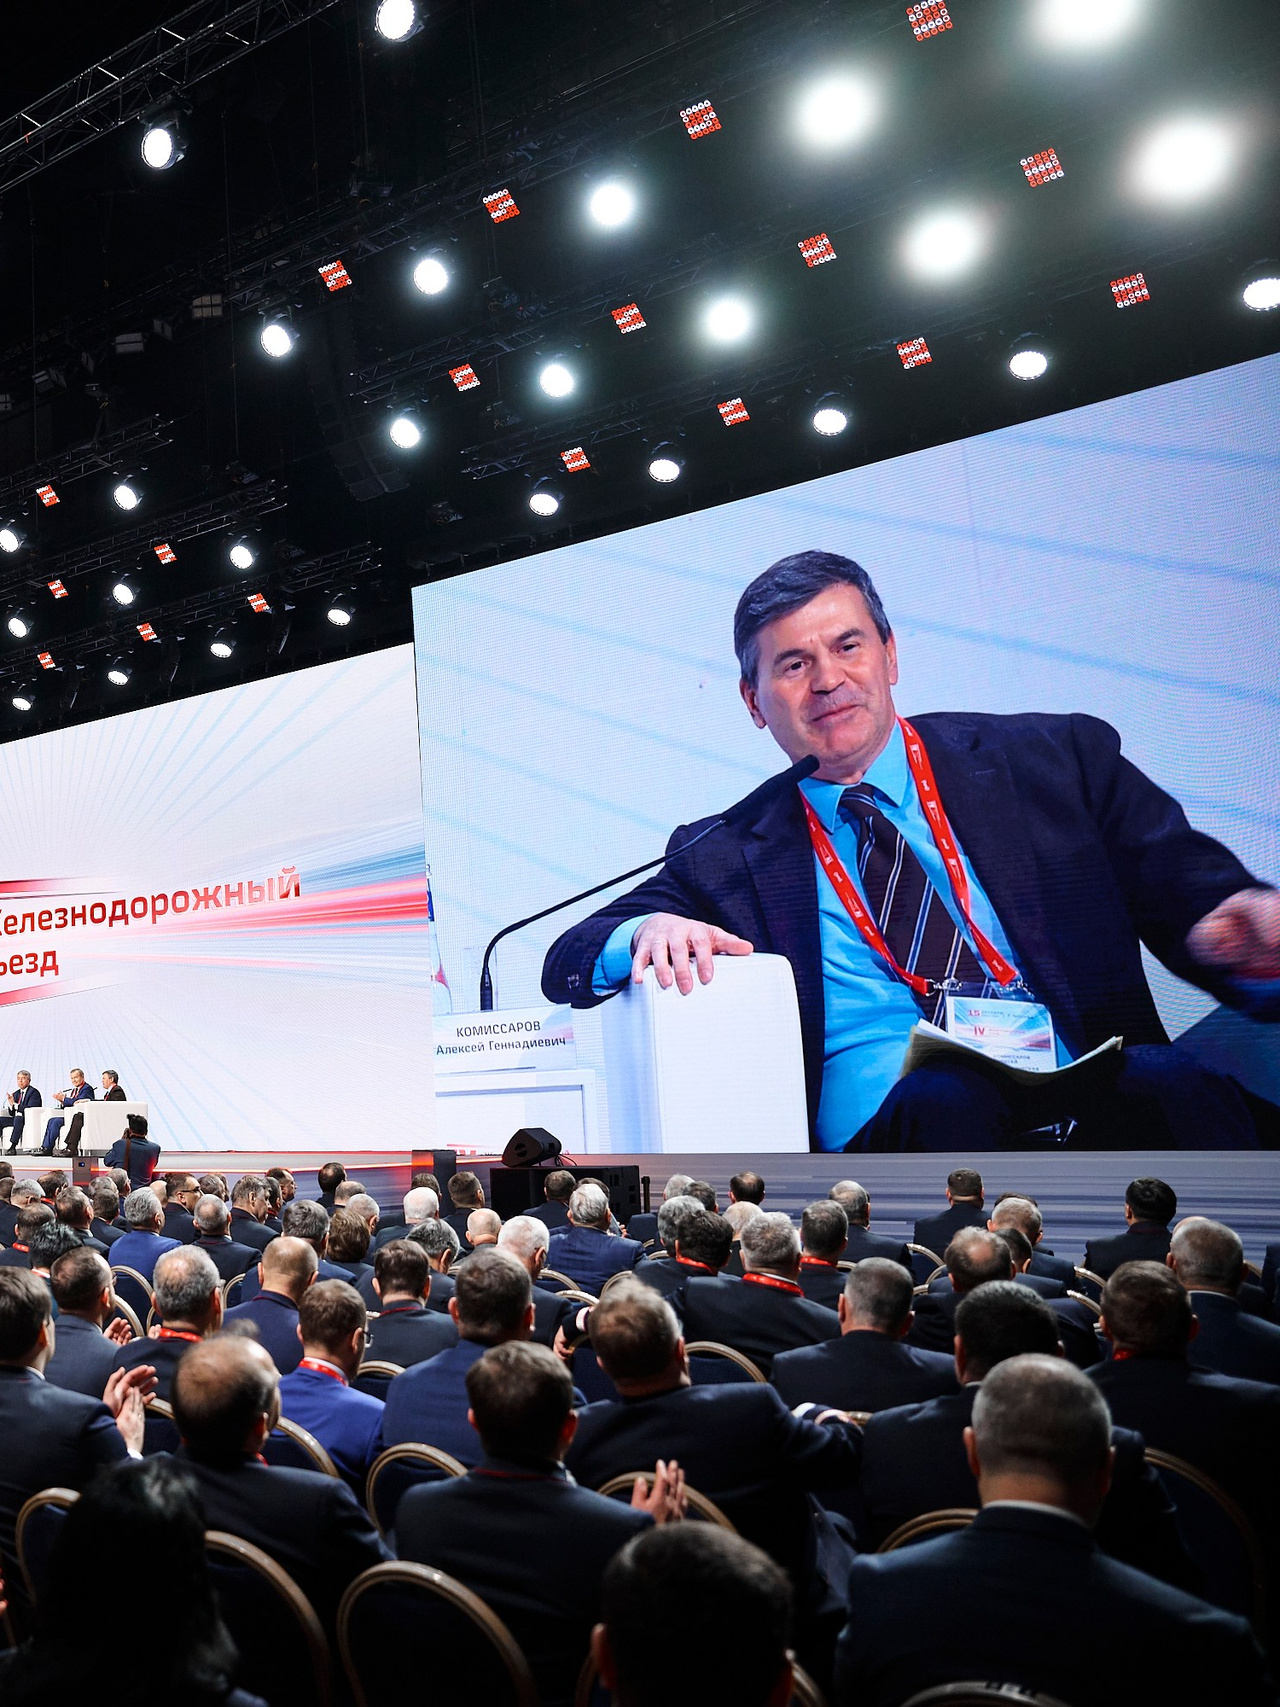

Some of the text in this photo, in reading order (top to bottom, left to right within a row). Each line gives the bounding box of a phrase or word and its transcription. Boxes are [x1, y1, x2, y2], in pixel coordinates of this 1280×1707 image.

[456, 1020, 541, 1038] КОМИССАРОВ
[974, 1026, 985, 1036] IV
[436, 1037, 566, 1056] Алексей Геннадиевич
